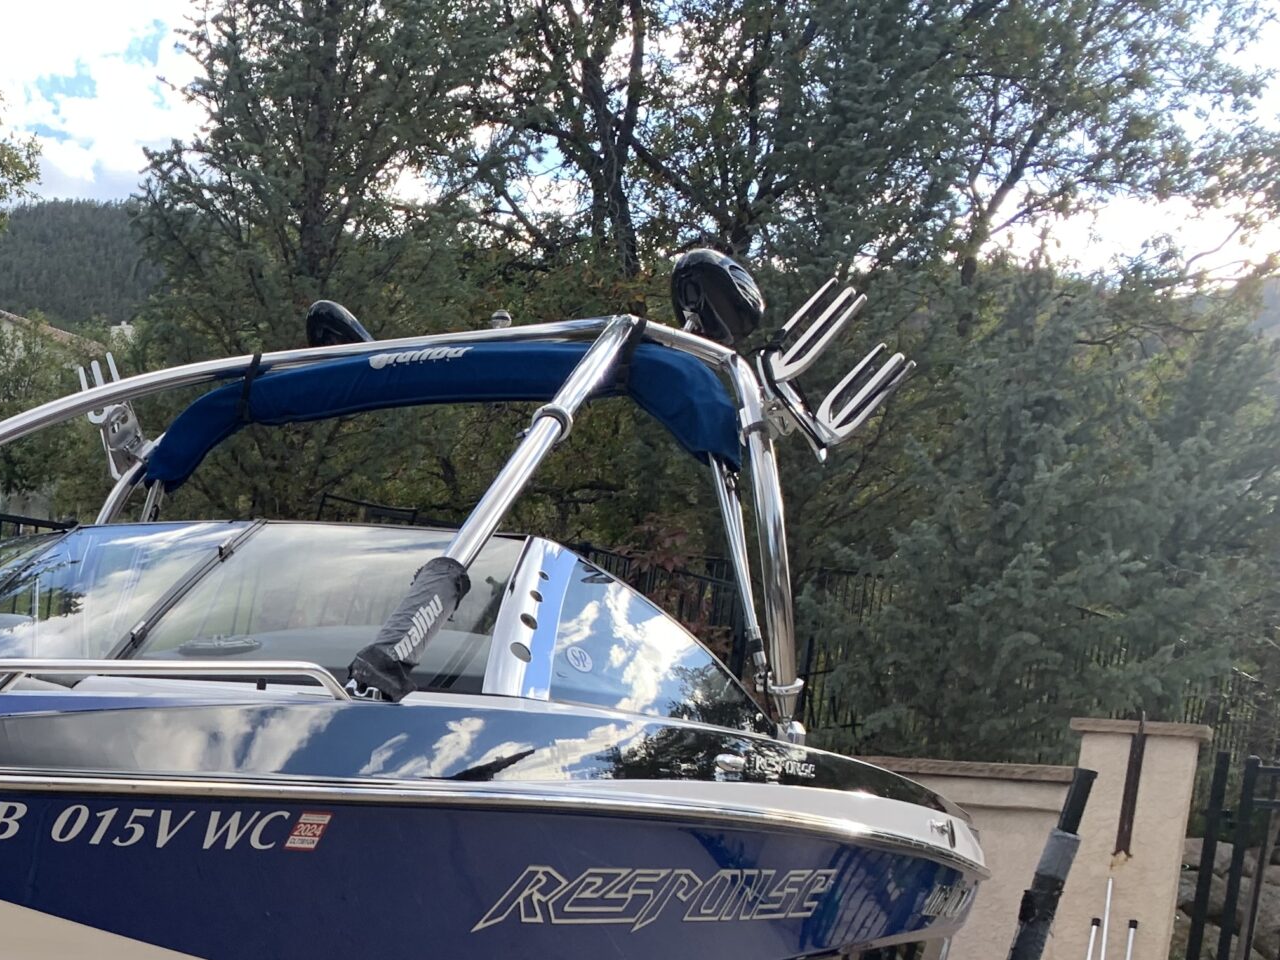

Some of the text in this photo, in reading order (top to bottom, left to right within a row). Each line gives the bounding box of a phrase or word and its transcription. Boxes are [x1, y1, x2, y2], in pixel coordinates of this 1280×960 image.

[393, 594, 444, 661] malibu
[51, 804, 196, 848] 015V
[202, 810, 291, 850] WC
[292, 823, 324, 836] 2024
